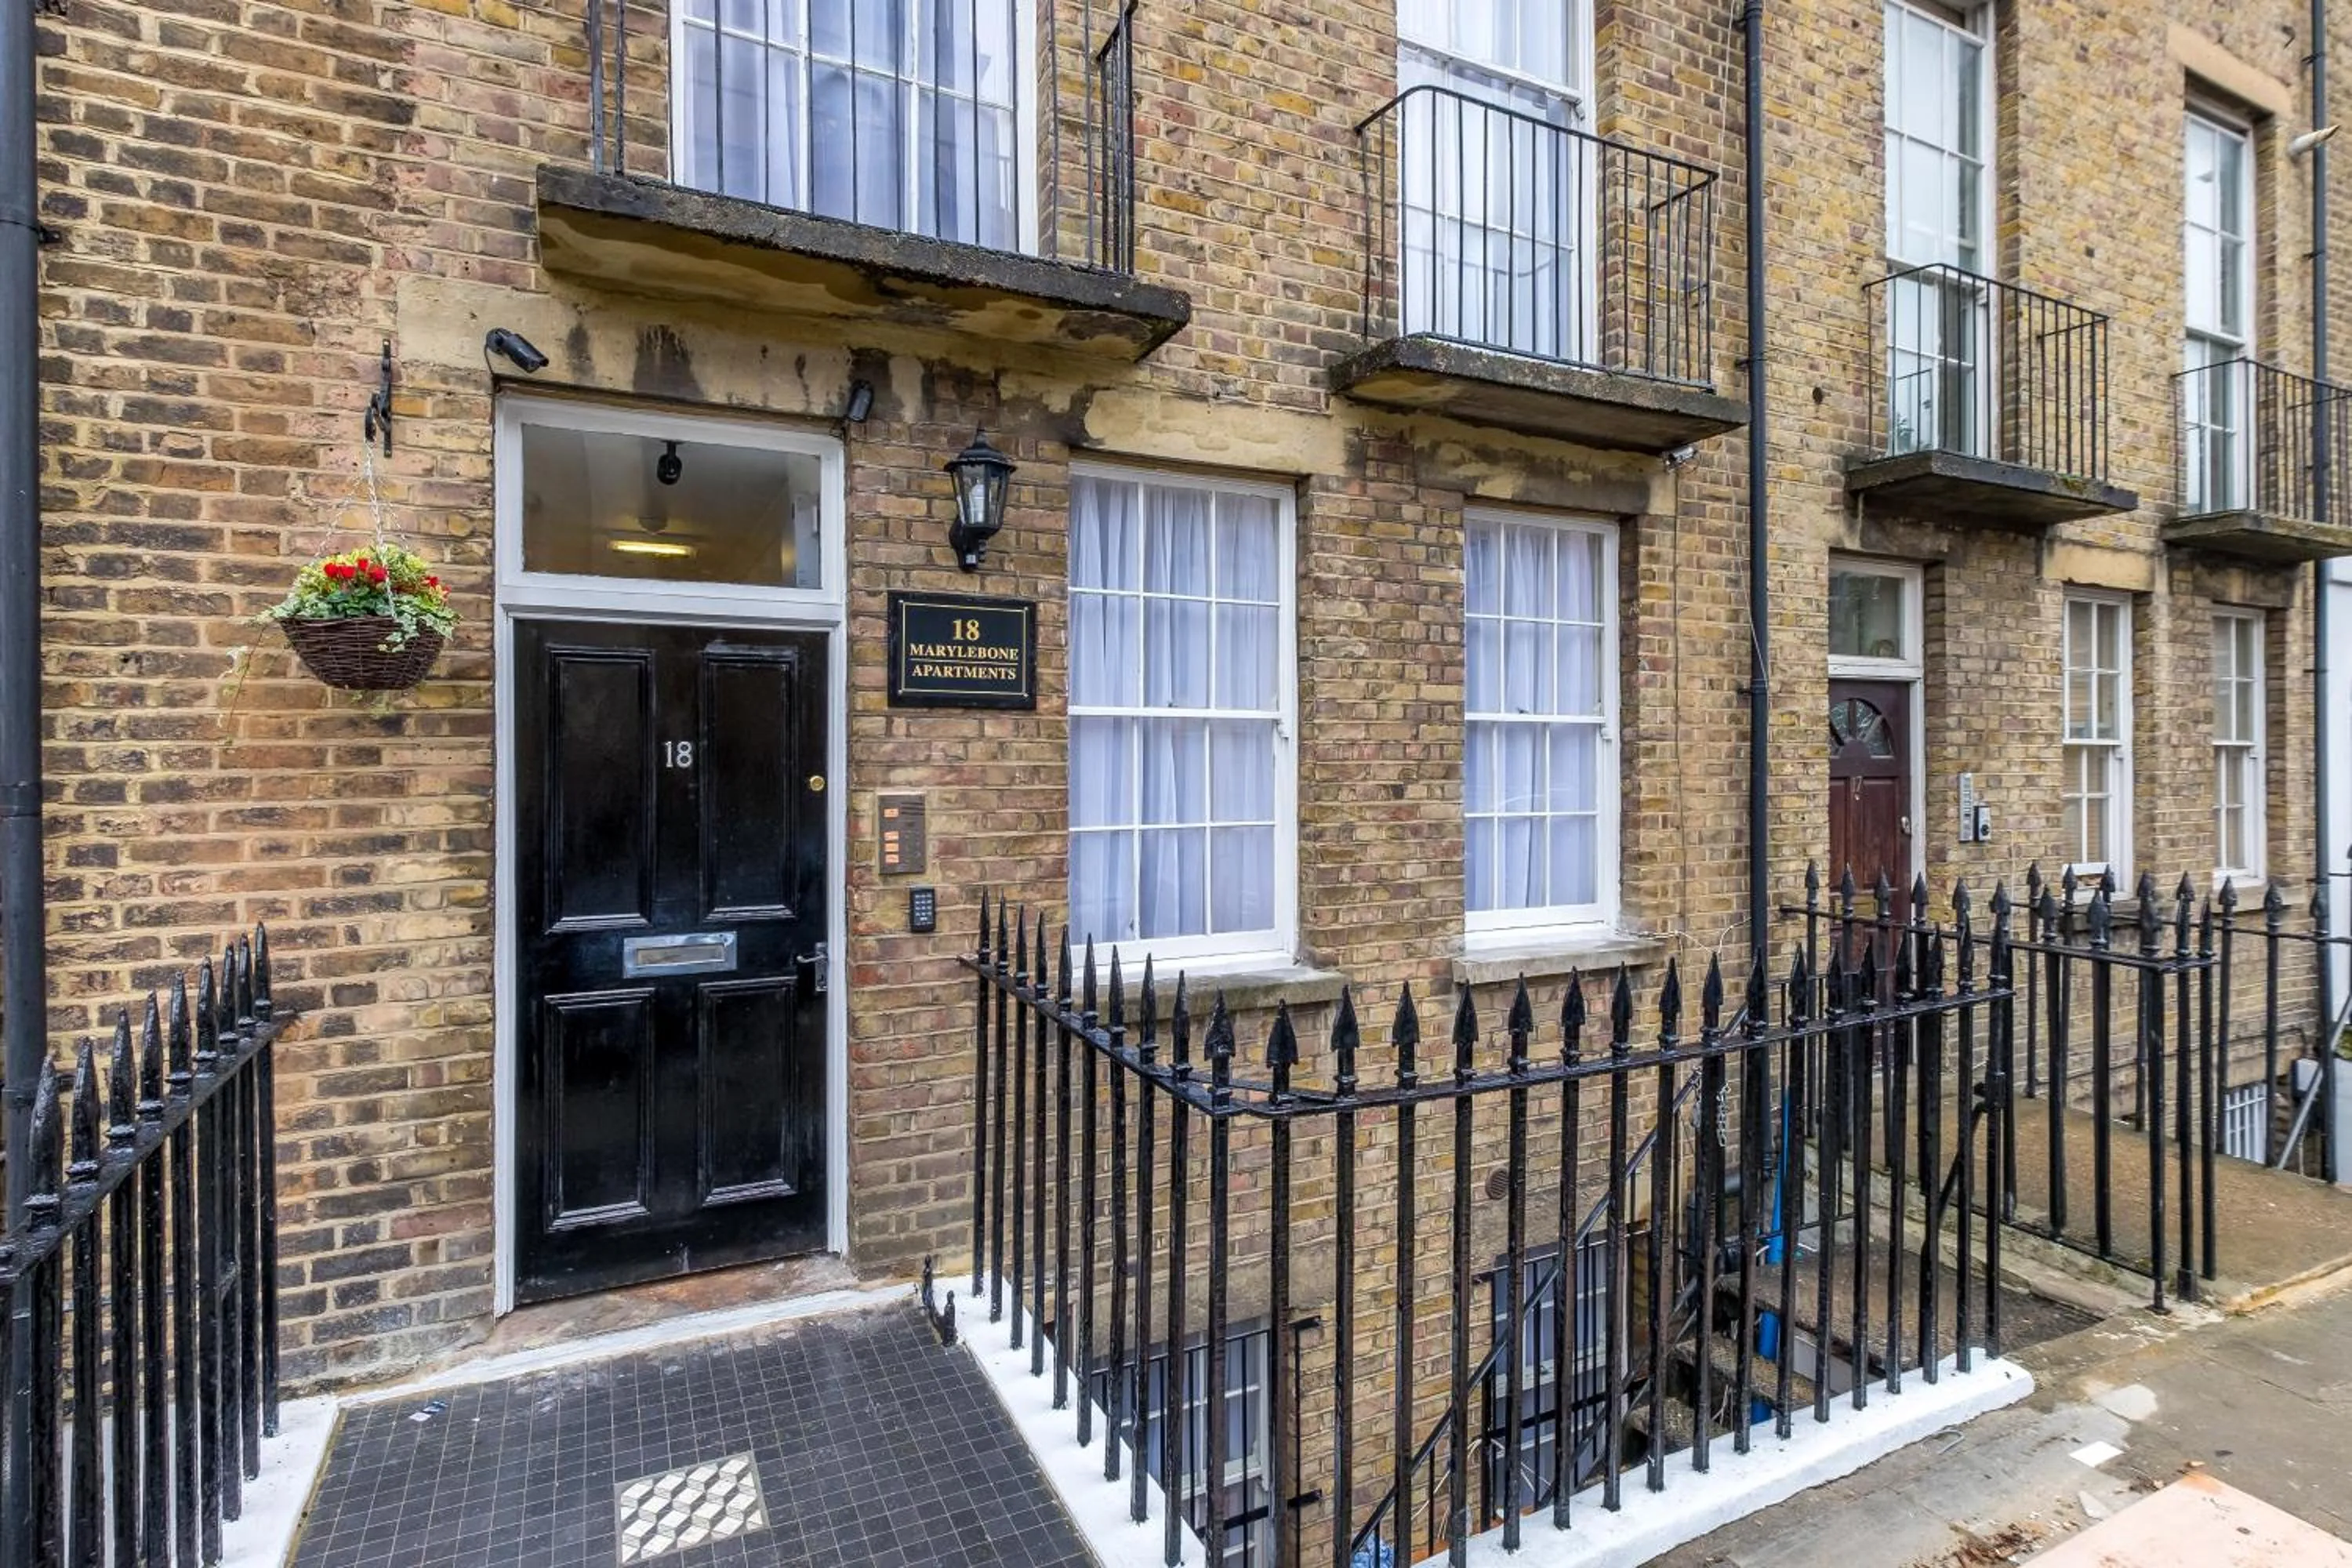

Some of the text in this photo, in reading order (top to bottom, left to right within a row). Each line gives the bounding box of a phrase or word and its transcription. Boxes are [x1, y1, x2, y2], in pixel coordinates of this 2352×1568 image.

[953, 619, 979, 641] 18
[909, 644, 1018, 660] MARYLEBONE
[912, 665, 1017, 680] APARTMENTS
[664, 741, 692, 768] 18
